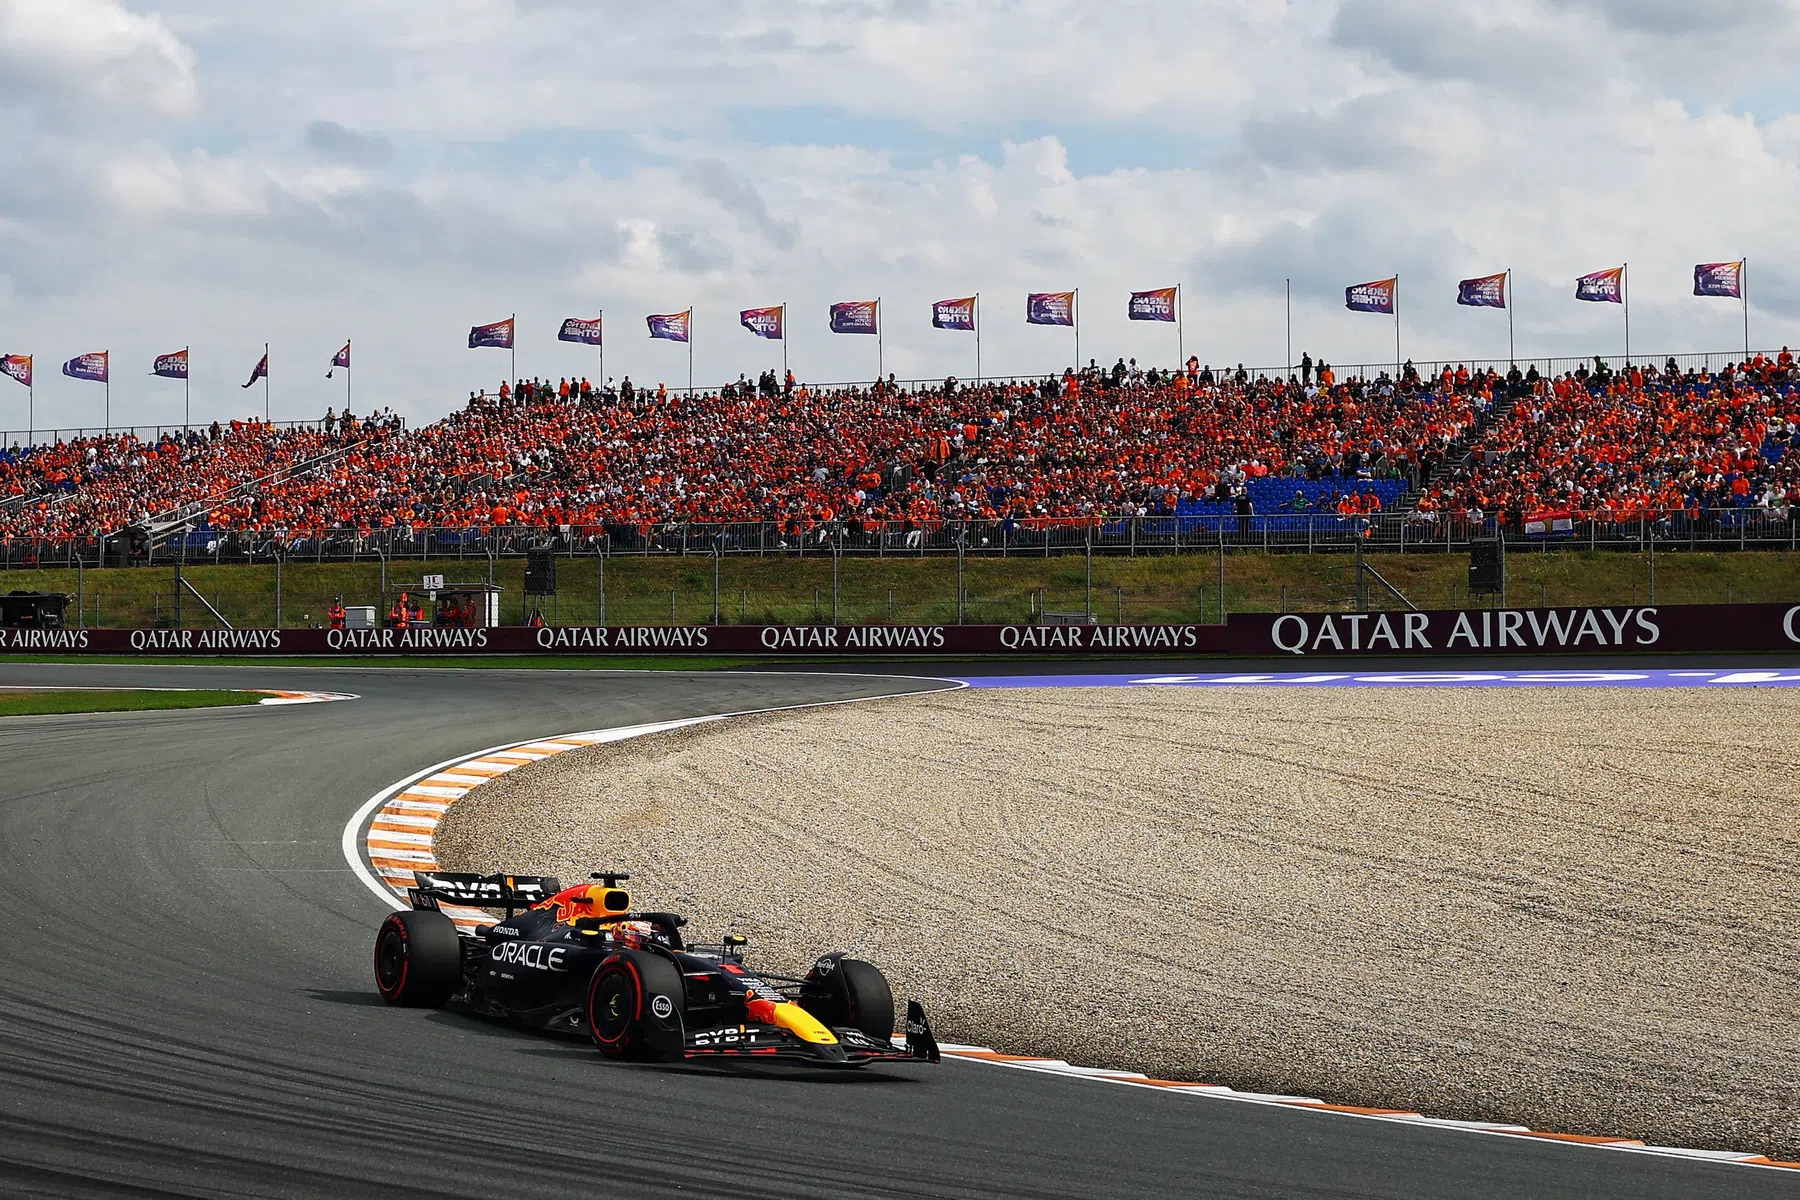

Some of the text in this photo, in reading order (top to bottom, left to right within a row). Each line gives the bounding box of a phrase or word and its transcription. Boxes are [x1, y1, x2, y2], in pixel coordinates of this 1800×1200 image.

[12, 629, 88, 648] AIRWAYS
[130, 629, 281, 650] QATAR AIRWAYS
[326, 628, 488, 649] QATAR AIRWAYS
[536, 627, 708, 648] QATAR AIRWAYS
[761, 627, 945, 649] QATAR AIRWAYS
[999, 626, 1197, 648] QATAR AIRWAYS
[1271, 607, 1660, 654] QATAR AIRWAYS
[493, 925, 519, 937] HONDA
[492, 941, 569, 972] ORACLE
